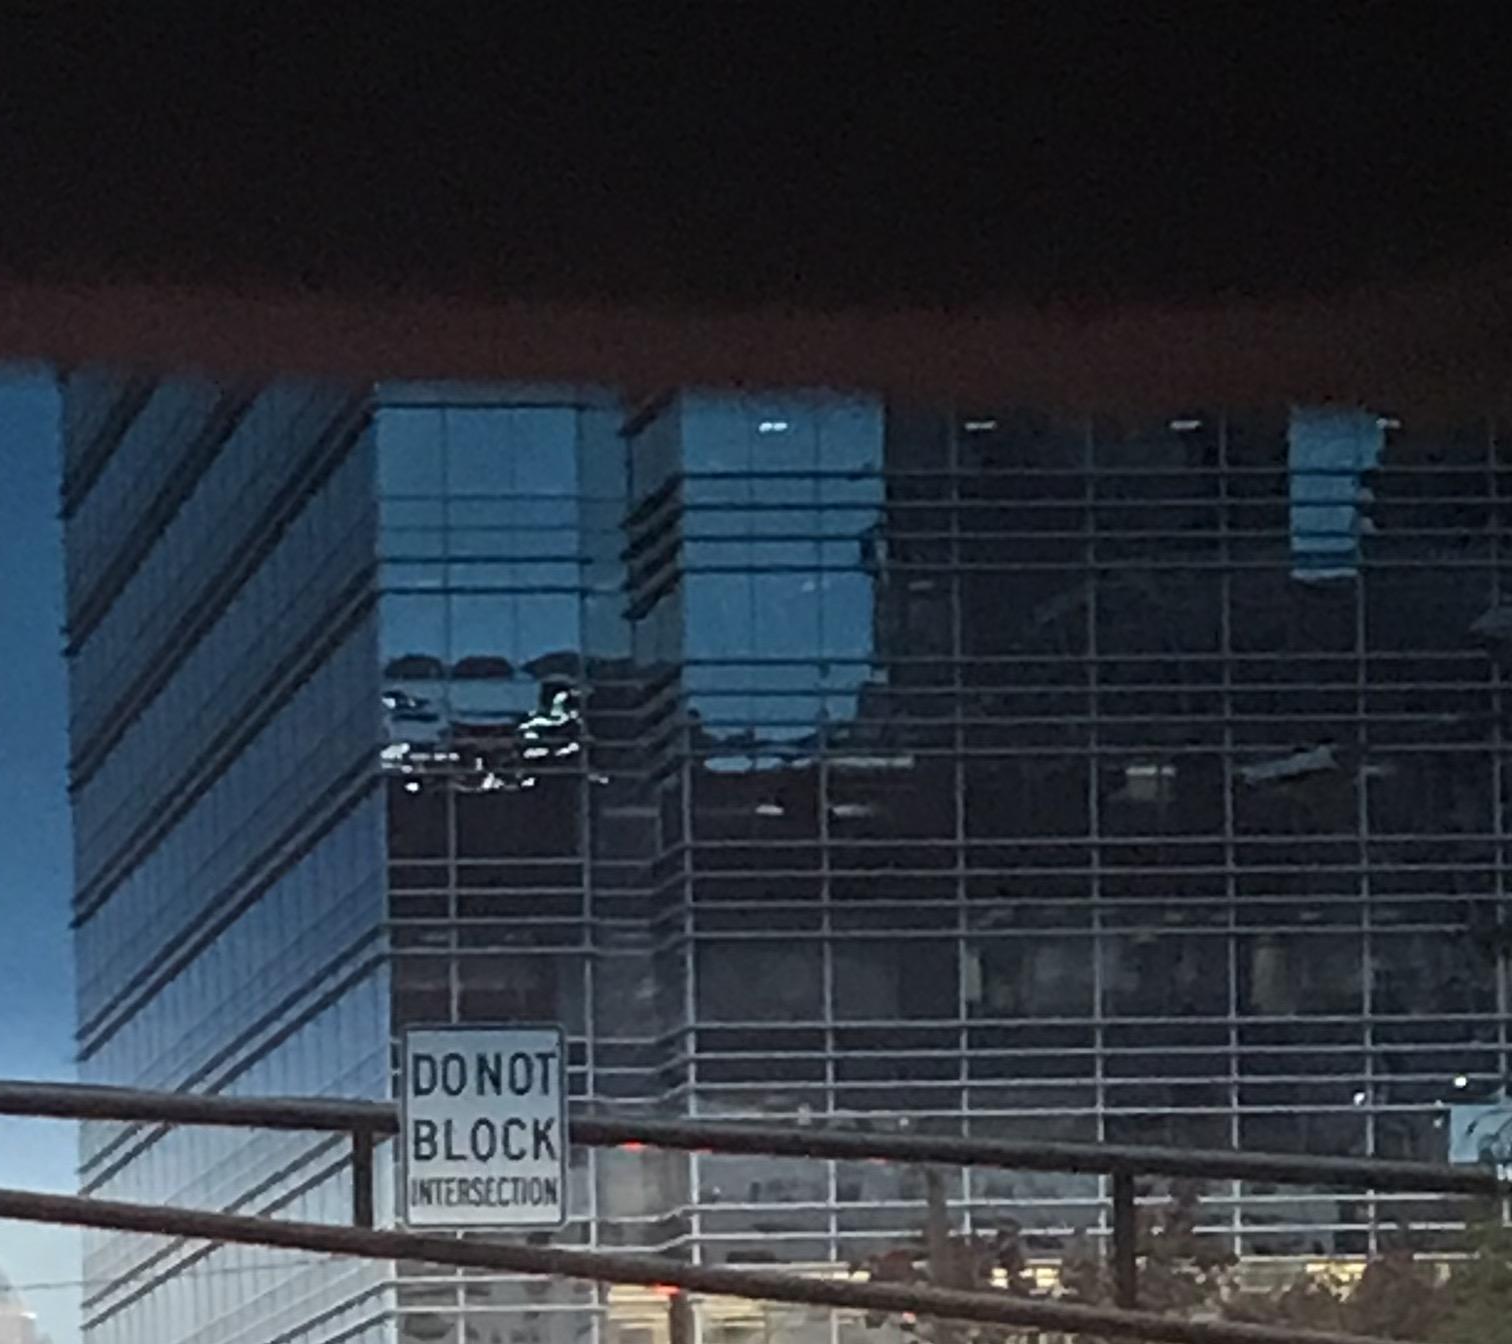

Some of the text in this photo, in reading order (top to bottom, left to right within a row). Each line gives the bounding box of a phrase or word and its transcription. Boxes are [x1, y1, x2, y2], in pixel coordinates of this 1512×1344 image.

[412, 1052, 557, 1096] DO NOT
[413, 1117, 556, 1162] BLOCK
[411, 1176, 557, 1207] INTERSECTION
